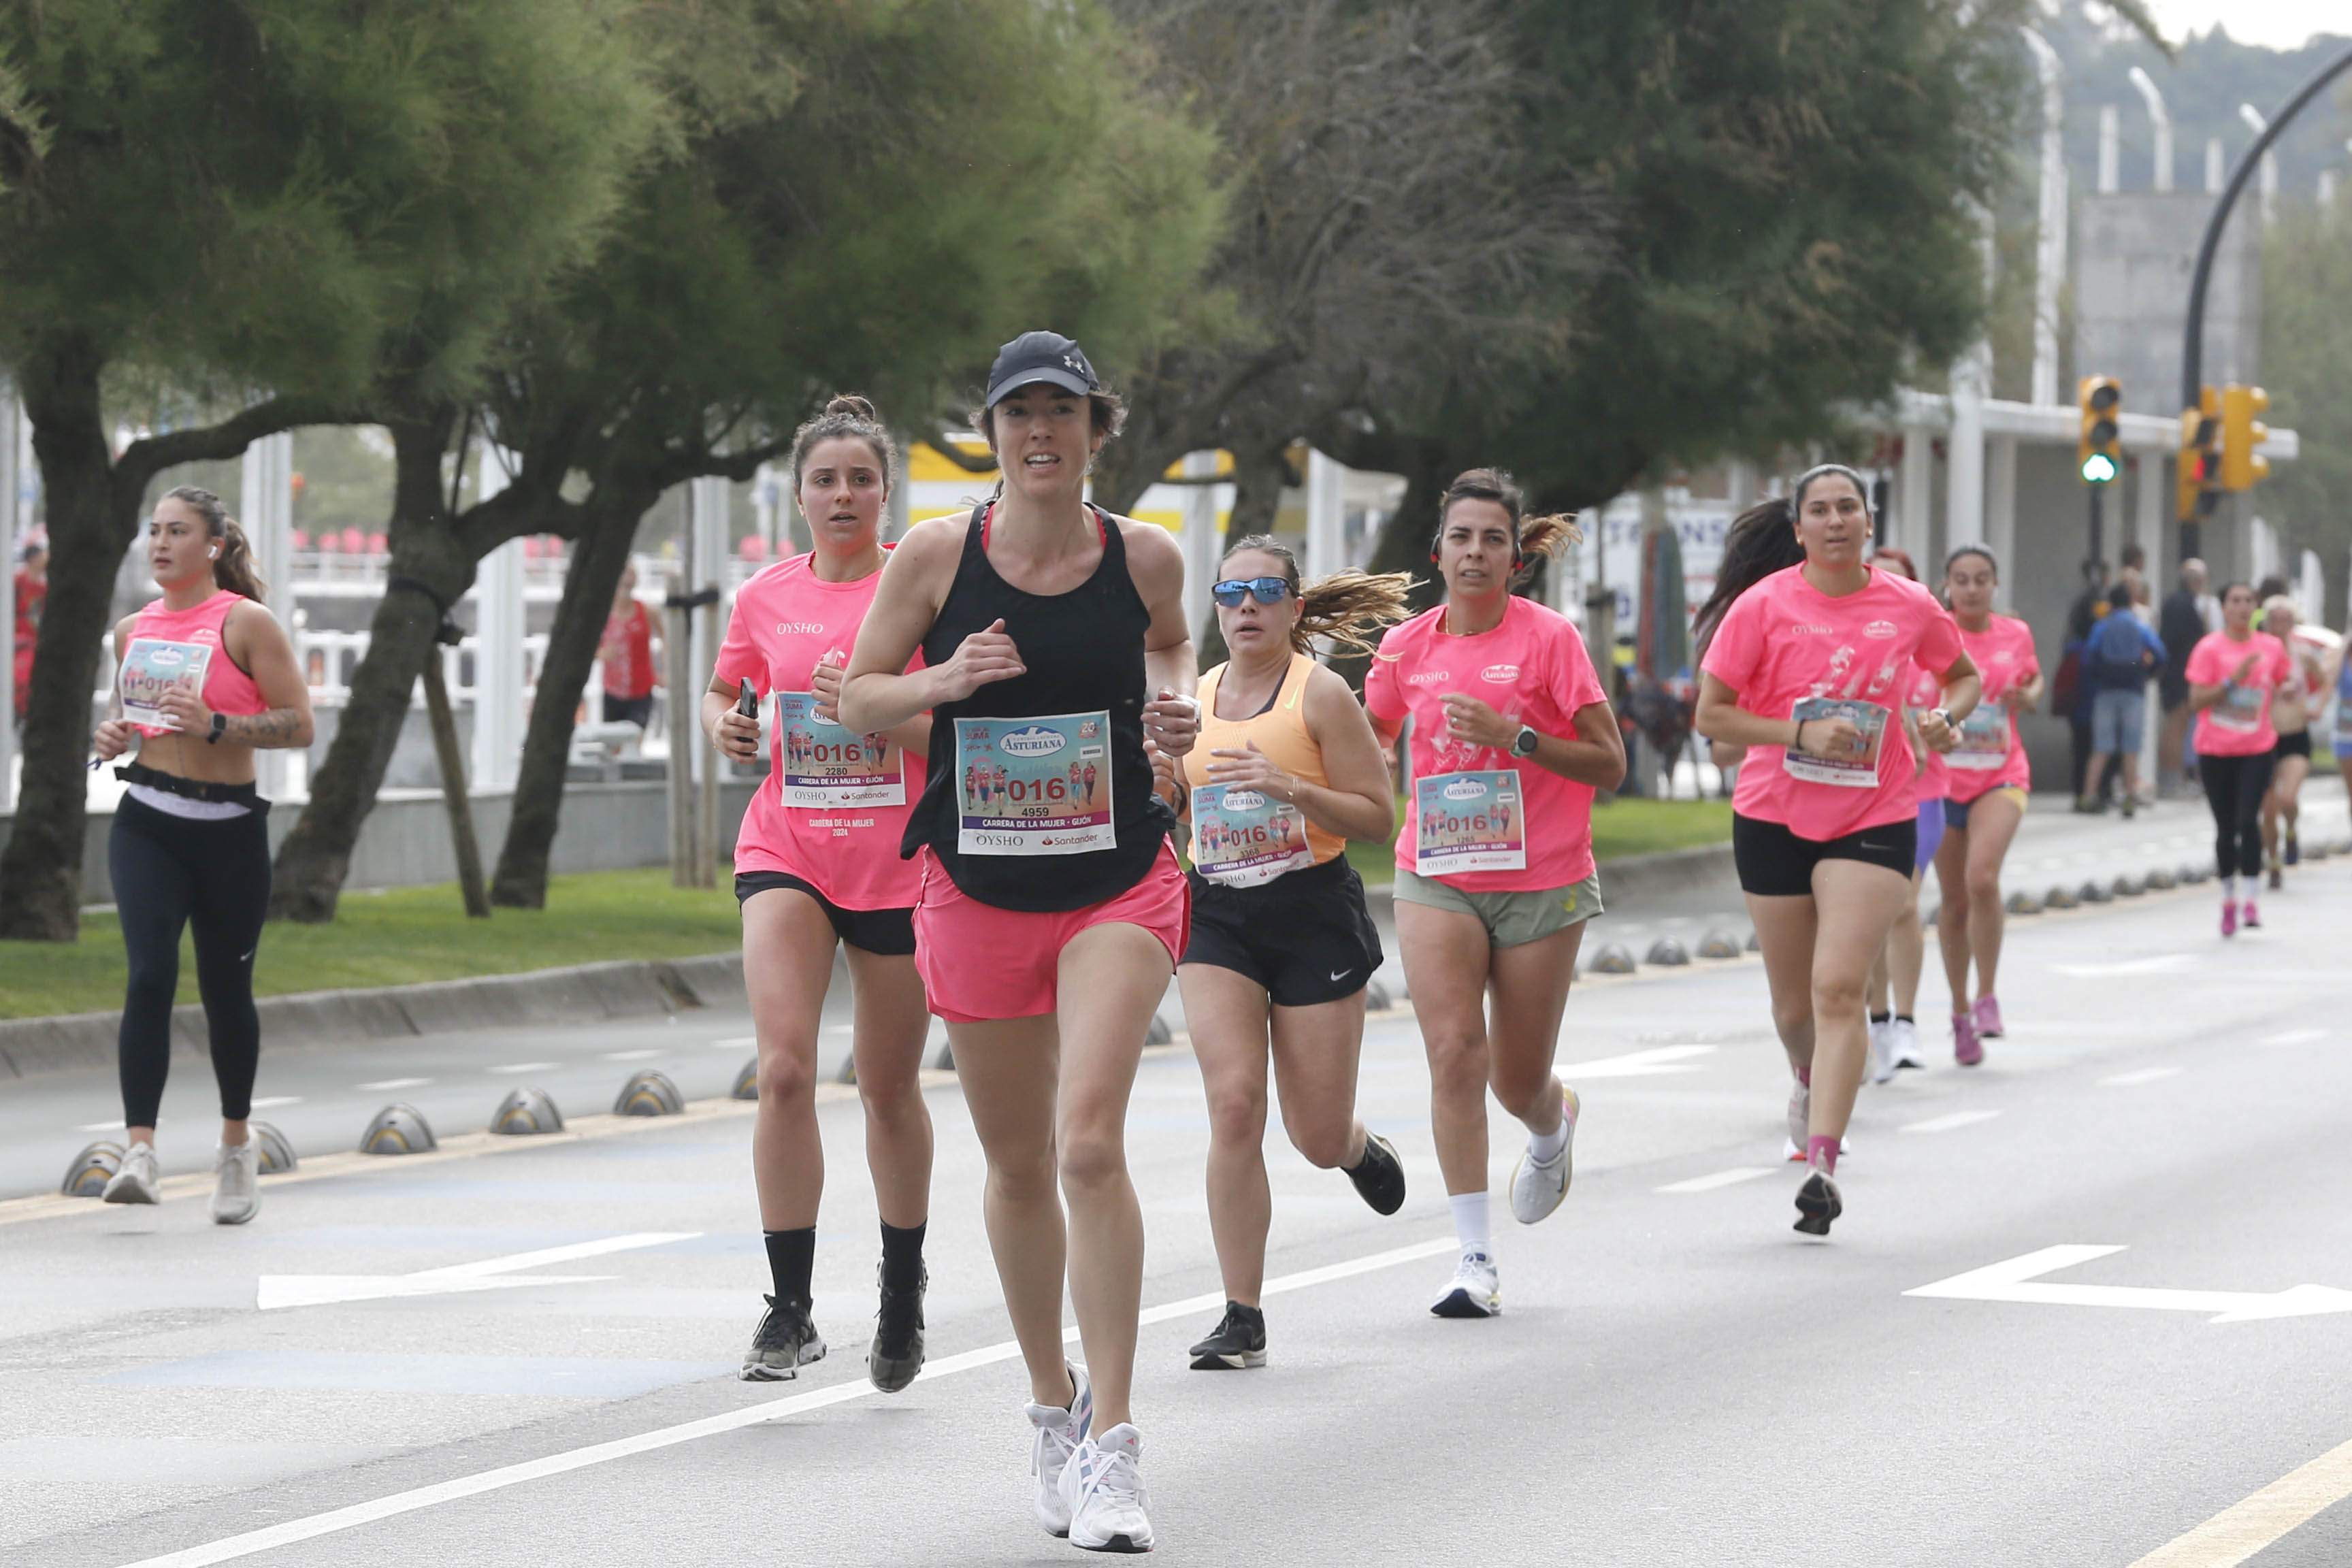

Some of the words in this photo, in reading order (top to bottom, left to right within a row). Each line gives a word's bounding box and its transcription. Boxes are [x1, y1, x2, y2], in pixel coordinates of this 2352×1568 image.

[777, 622, 823, 635] OYSHO
[1410, 670, 1449, 683] OYSHO
[1004, 738, 1062, 751] ASTURIANA
[814, 744, 861, 762] 016
[826, 767, 848, 776] 2280
[795, 790, 827, 801] OYSHO
[851, 791, 889, 800] Santander
[1009, 778, 1066, 801] 016
[1022, 807, 1049, 817] 4959
[809, 819, 833, 827] CARRERA
[834, 819, 843, 827] DE
[844, 819, 851, 827] LA
[852, 819, 875, 827] MUJER
[982, 819, 1015, 828] CARRERA
[1017, 819, 1026, 828] DE
[1028, 820, 1038, 828] LA
[1039, 819, 1066, 828] MUJER
[1072, 815, 1092, 826] GIJÓN
[1448, 815, 1487, 833] 016
[977, 834, 1024, 847] OYSHO
[1055, 833, 1098, 845] Santander
[1231, 826, 1267, 846] 016
[1213, 861, 1239, 871] CARRERA
[1247, 858, 1254, 866] LA
